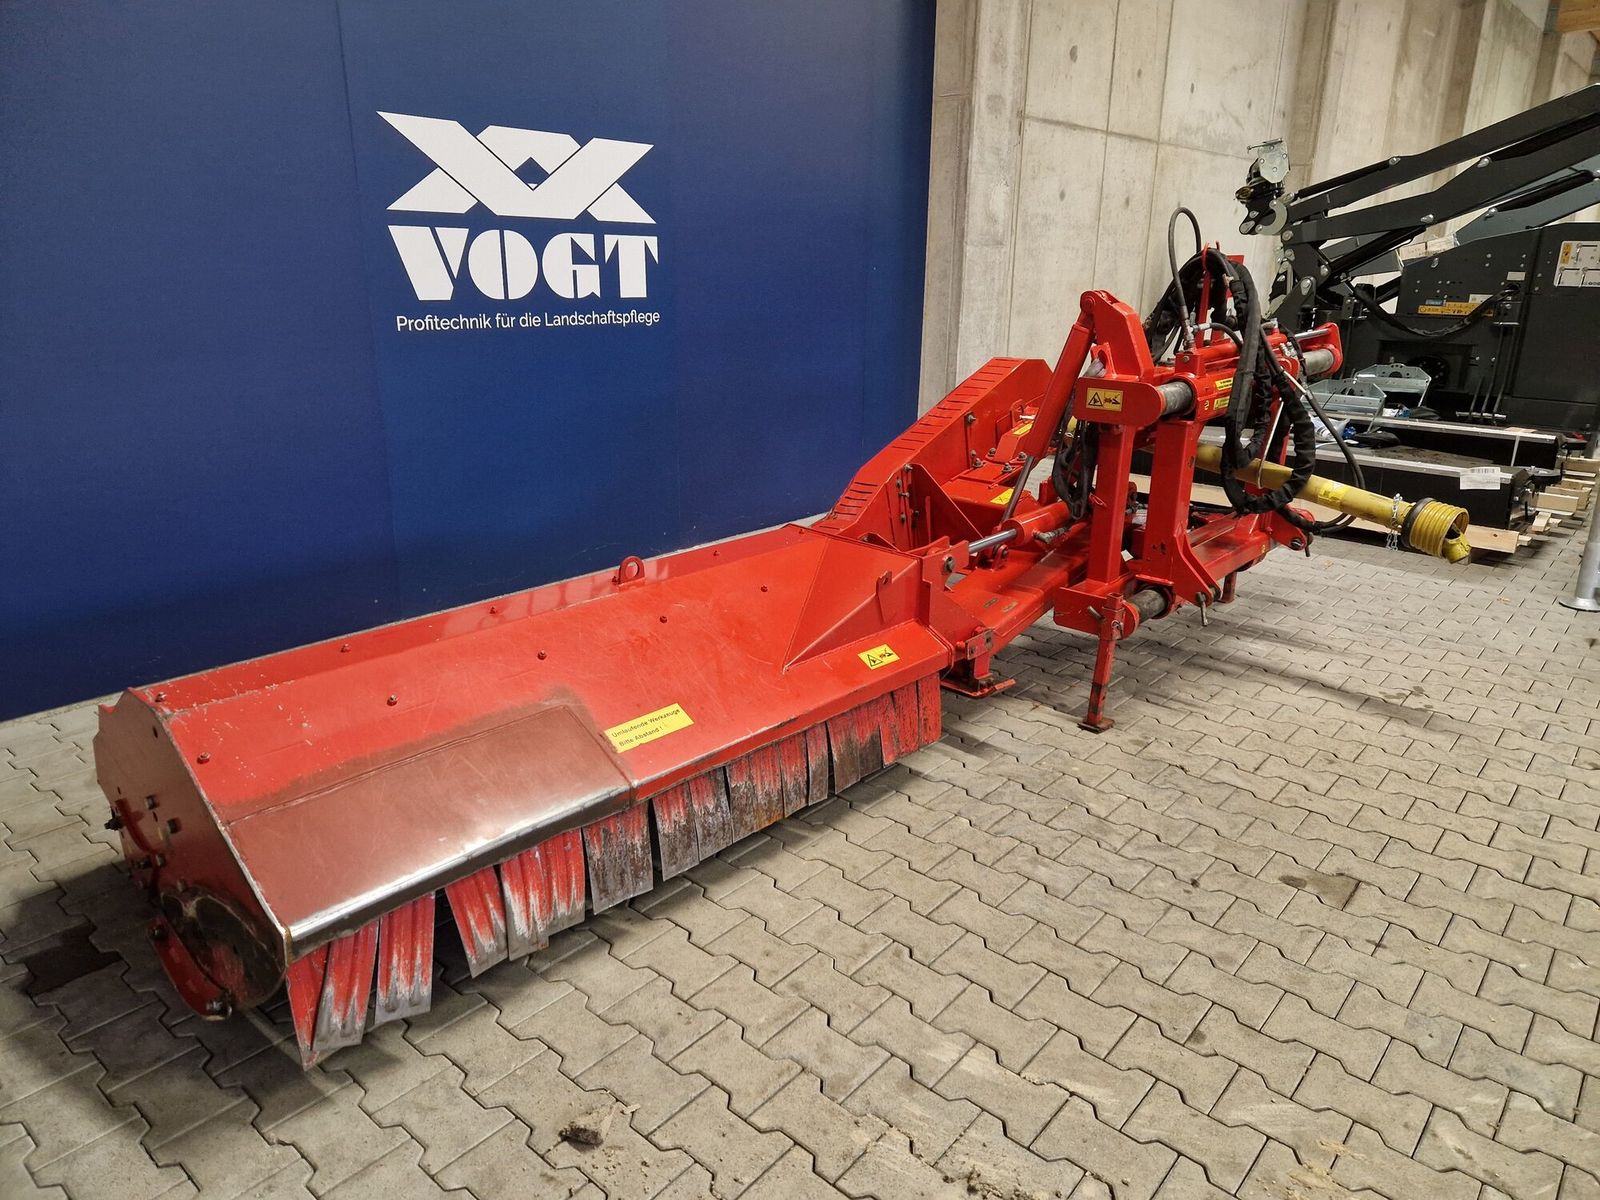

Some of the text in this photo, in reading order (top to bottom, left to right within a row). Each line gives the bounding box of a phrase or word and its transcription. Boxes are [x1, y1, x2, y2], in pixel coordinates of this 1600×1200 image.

[388, 225, 658, 300] VOGT
[396, 309, 660, 331] Profitechnik für die Landschaftspflege
[612, 721, 648, 738] Umlaufende
[619, 738, 634, 747] Bitte
[635, 727, 660, 741] Abstand
